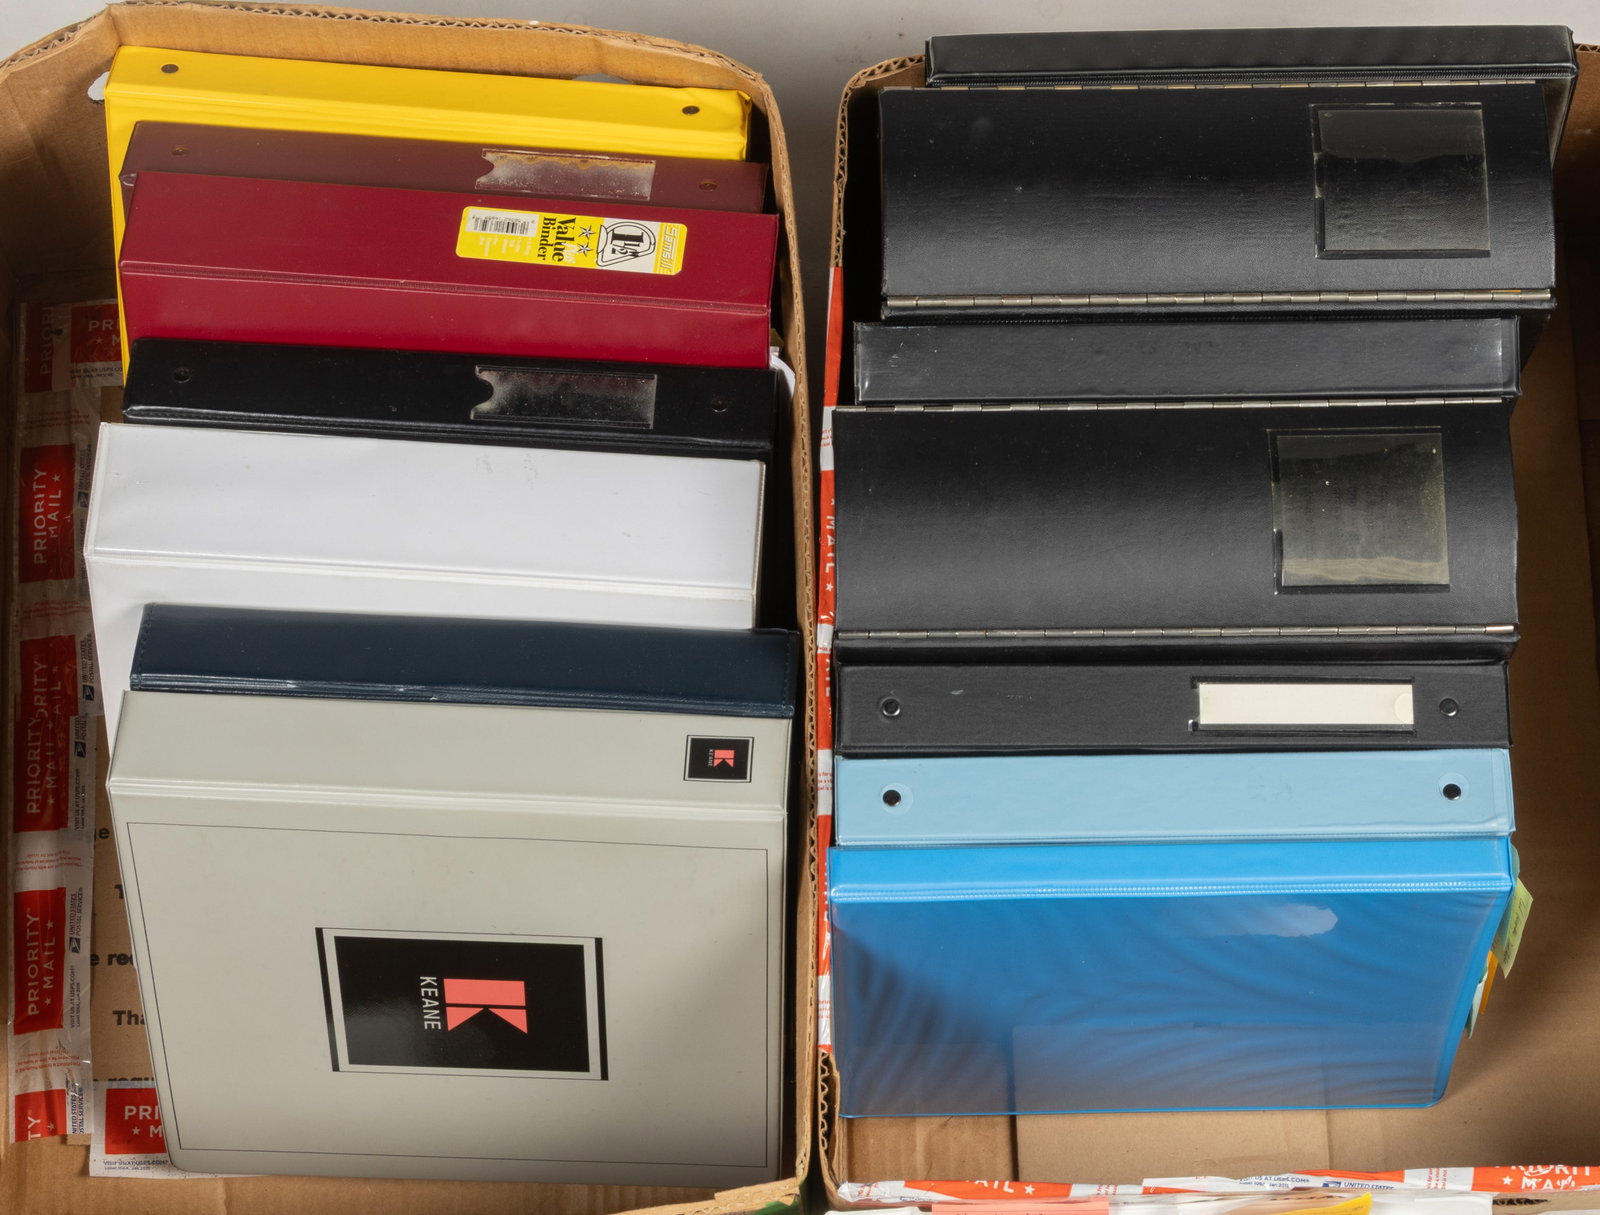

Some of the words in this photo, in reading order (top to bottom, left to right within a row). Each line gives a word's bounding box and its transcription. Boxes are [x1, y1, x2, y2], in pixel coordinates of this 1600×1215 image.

[537, 216, 557, 261] Binder
[552, 217, 577, 262] Value
[660, 225, 677, 272] Samsill
[33, 468, 48, 564] PRIORITY
[47, 489, 62, 538] MAIL
[26, 717, 41, 814] PRIORITY
[26, 914, 40, 1016] PRIORITY
[43, 936, 56, 989] MAIL
[419, 976, 441, 1030] KEANE
